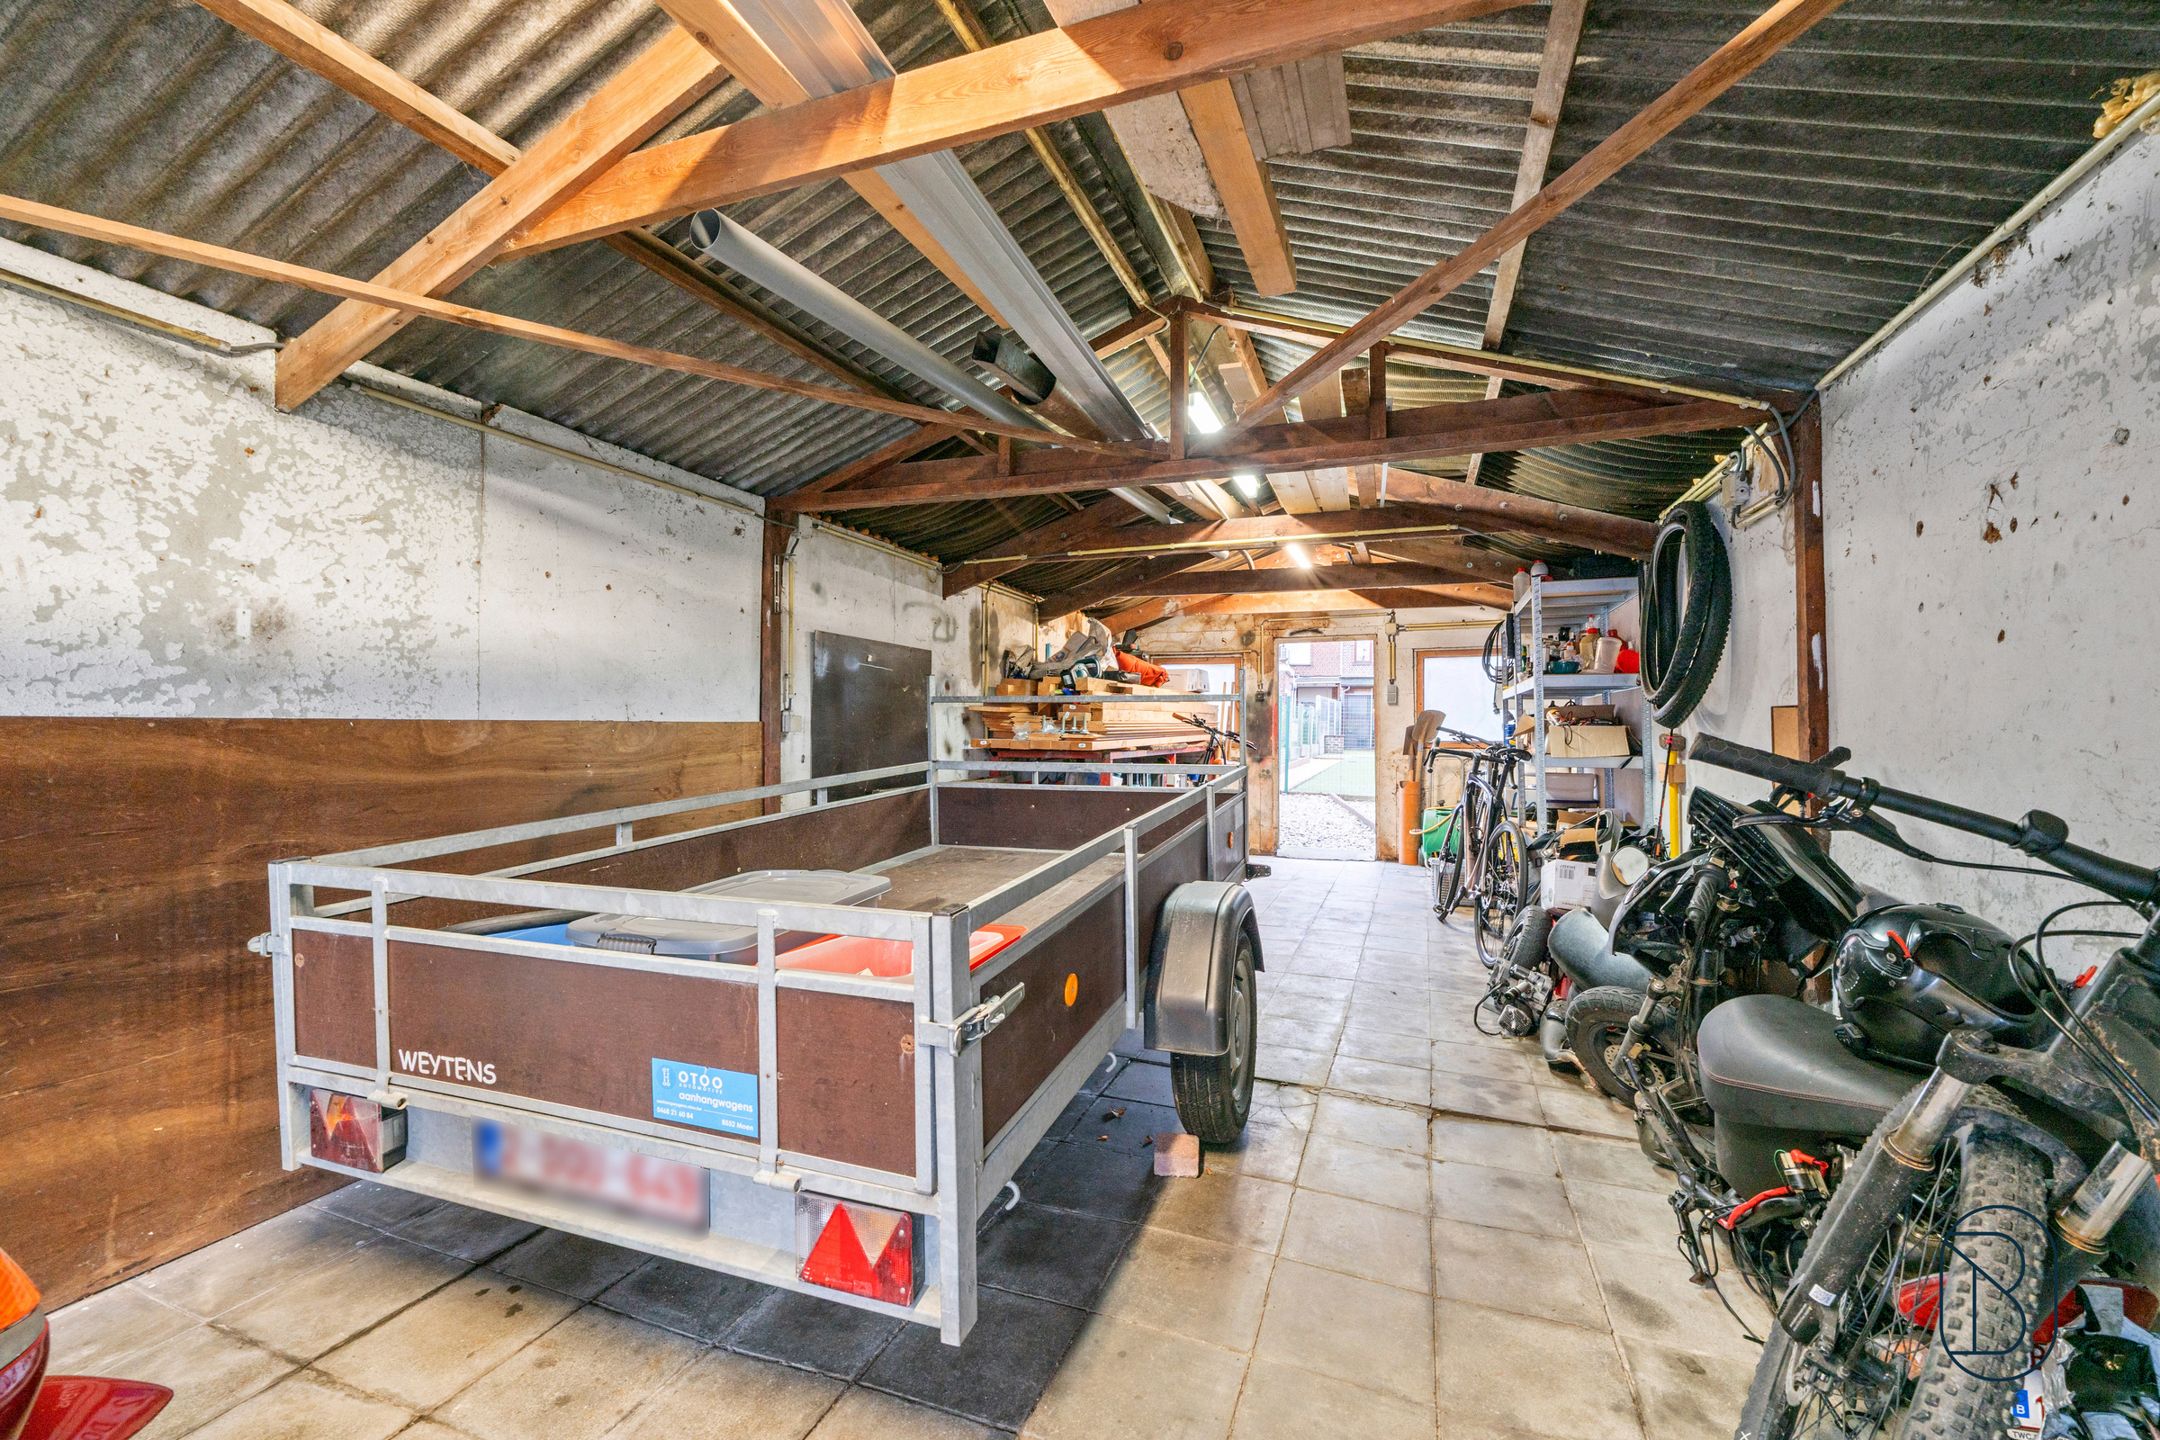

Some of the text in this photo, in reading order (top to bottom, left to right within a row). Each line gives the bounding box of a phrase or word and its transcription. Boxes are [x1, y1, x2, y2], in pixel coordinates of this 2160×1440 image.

[398, 1049, 497, 1085] WEYTENS
[678, 1071, 723, 1089] OTOO
[678, 1092, 753, 1113] aanhangwagens
[2016, 1404, 2026, 1415] B
